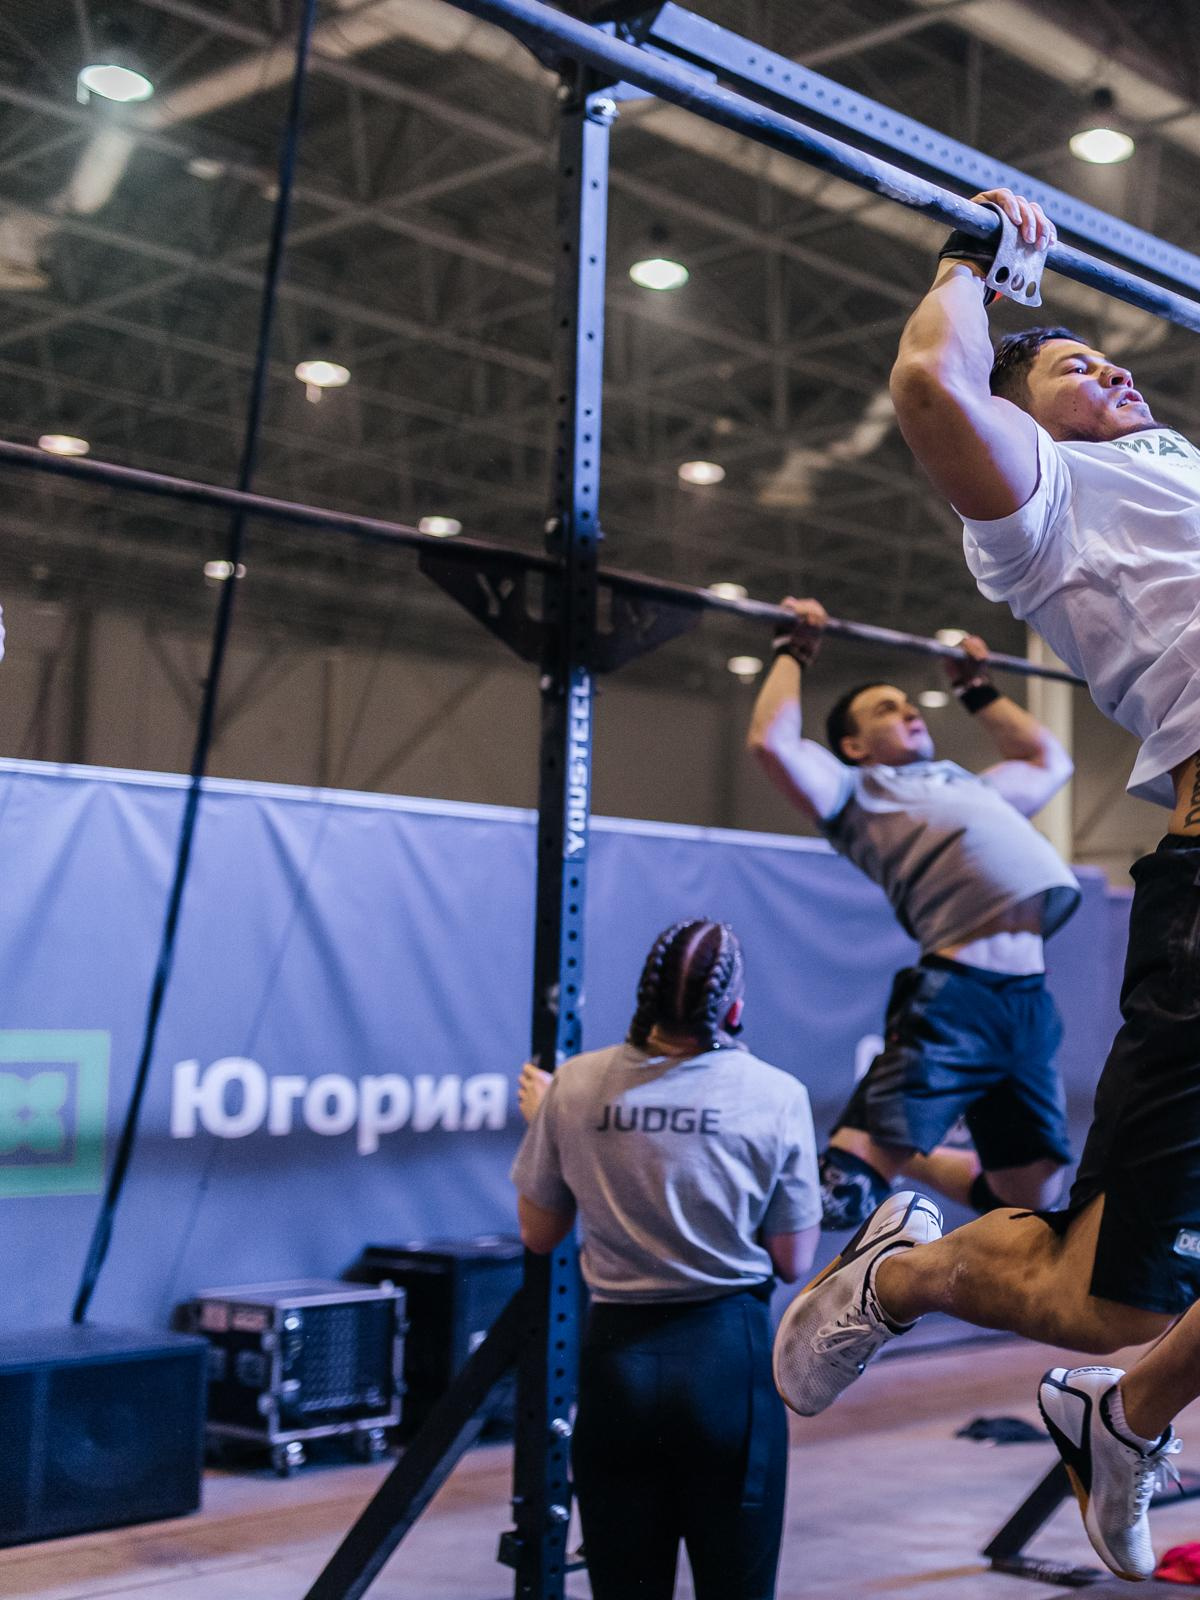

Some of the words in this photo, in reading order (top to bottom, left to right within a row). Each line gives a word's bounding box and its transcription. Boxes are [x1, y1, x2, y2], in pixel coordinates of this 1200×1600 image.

[567, 674, 590, 855] YOUSTEEL
[171, 1057, 509, 1156] Югория
[597, 1105, 722, 1135] JUDGE
